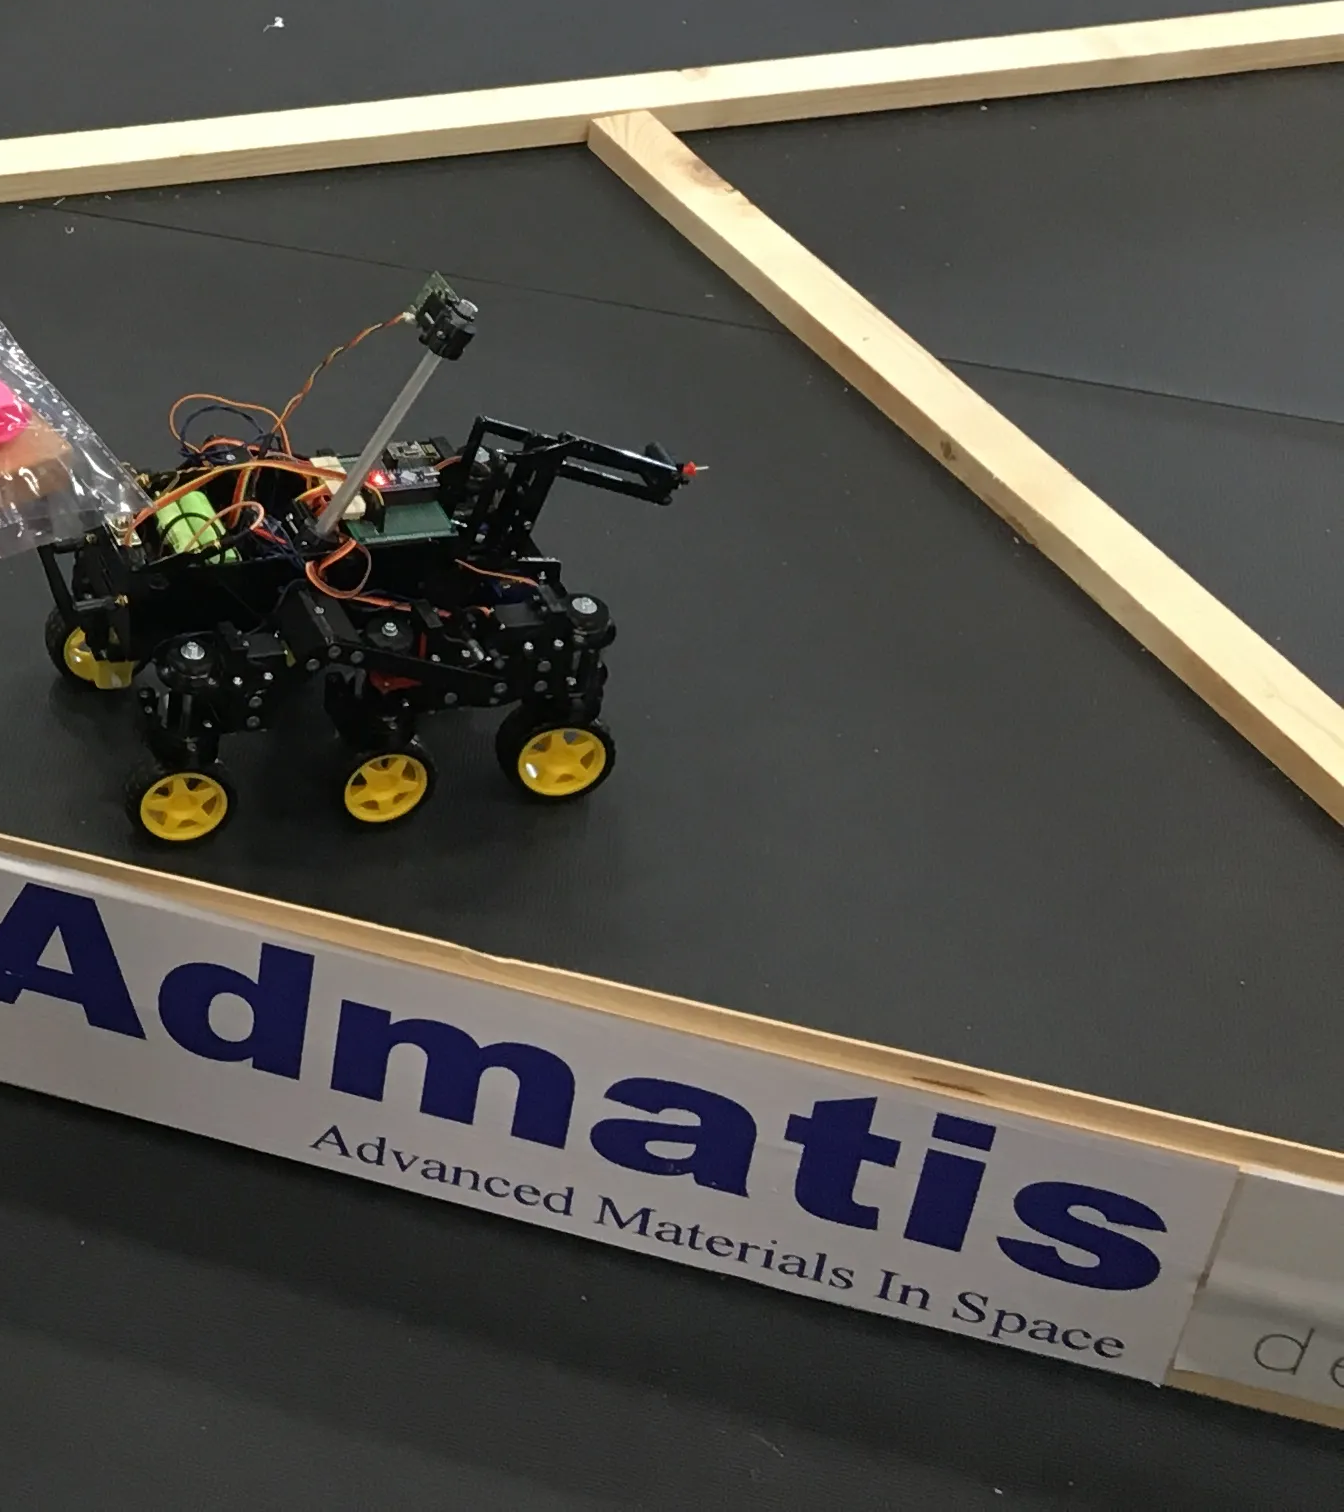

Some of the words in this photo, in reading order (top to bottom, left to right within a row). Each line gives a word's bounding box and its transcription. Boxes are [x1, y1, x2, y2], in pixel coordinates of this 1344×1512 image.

[310, 1124, 574, 1217] Advanced
[593, 1194, 855, 1290] Materials
[874, 1269, 930, 1311] In
[951, 1290, 1127, 1360] Space
